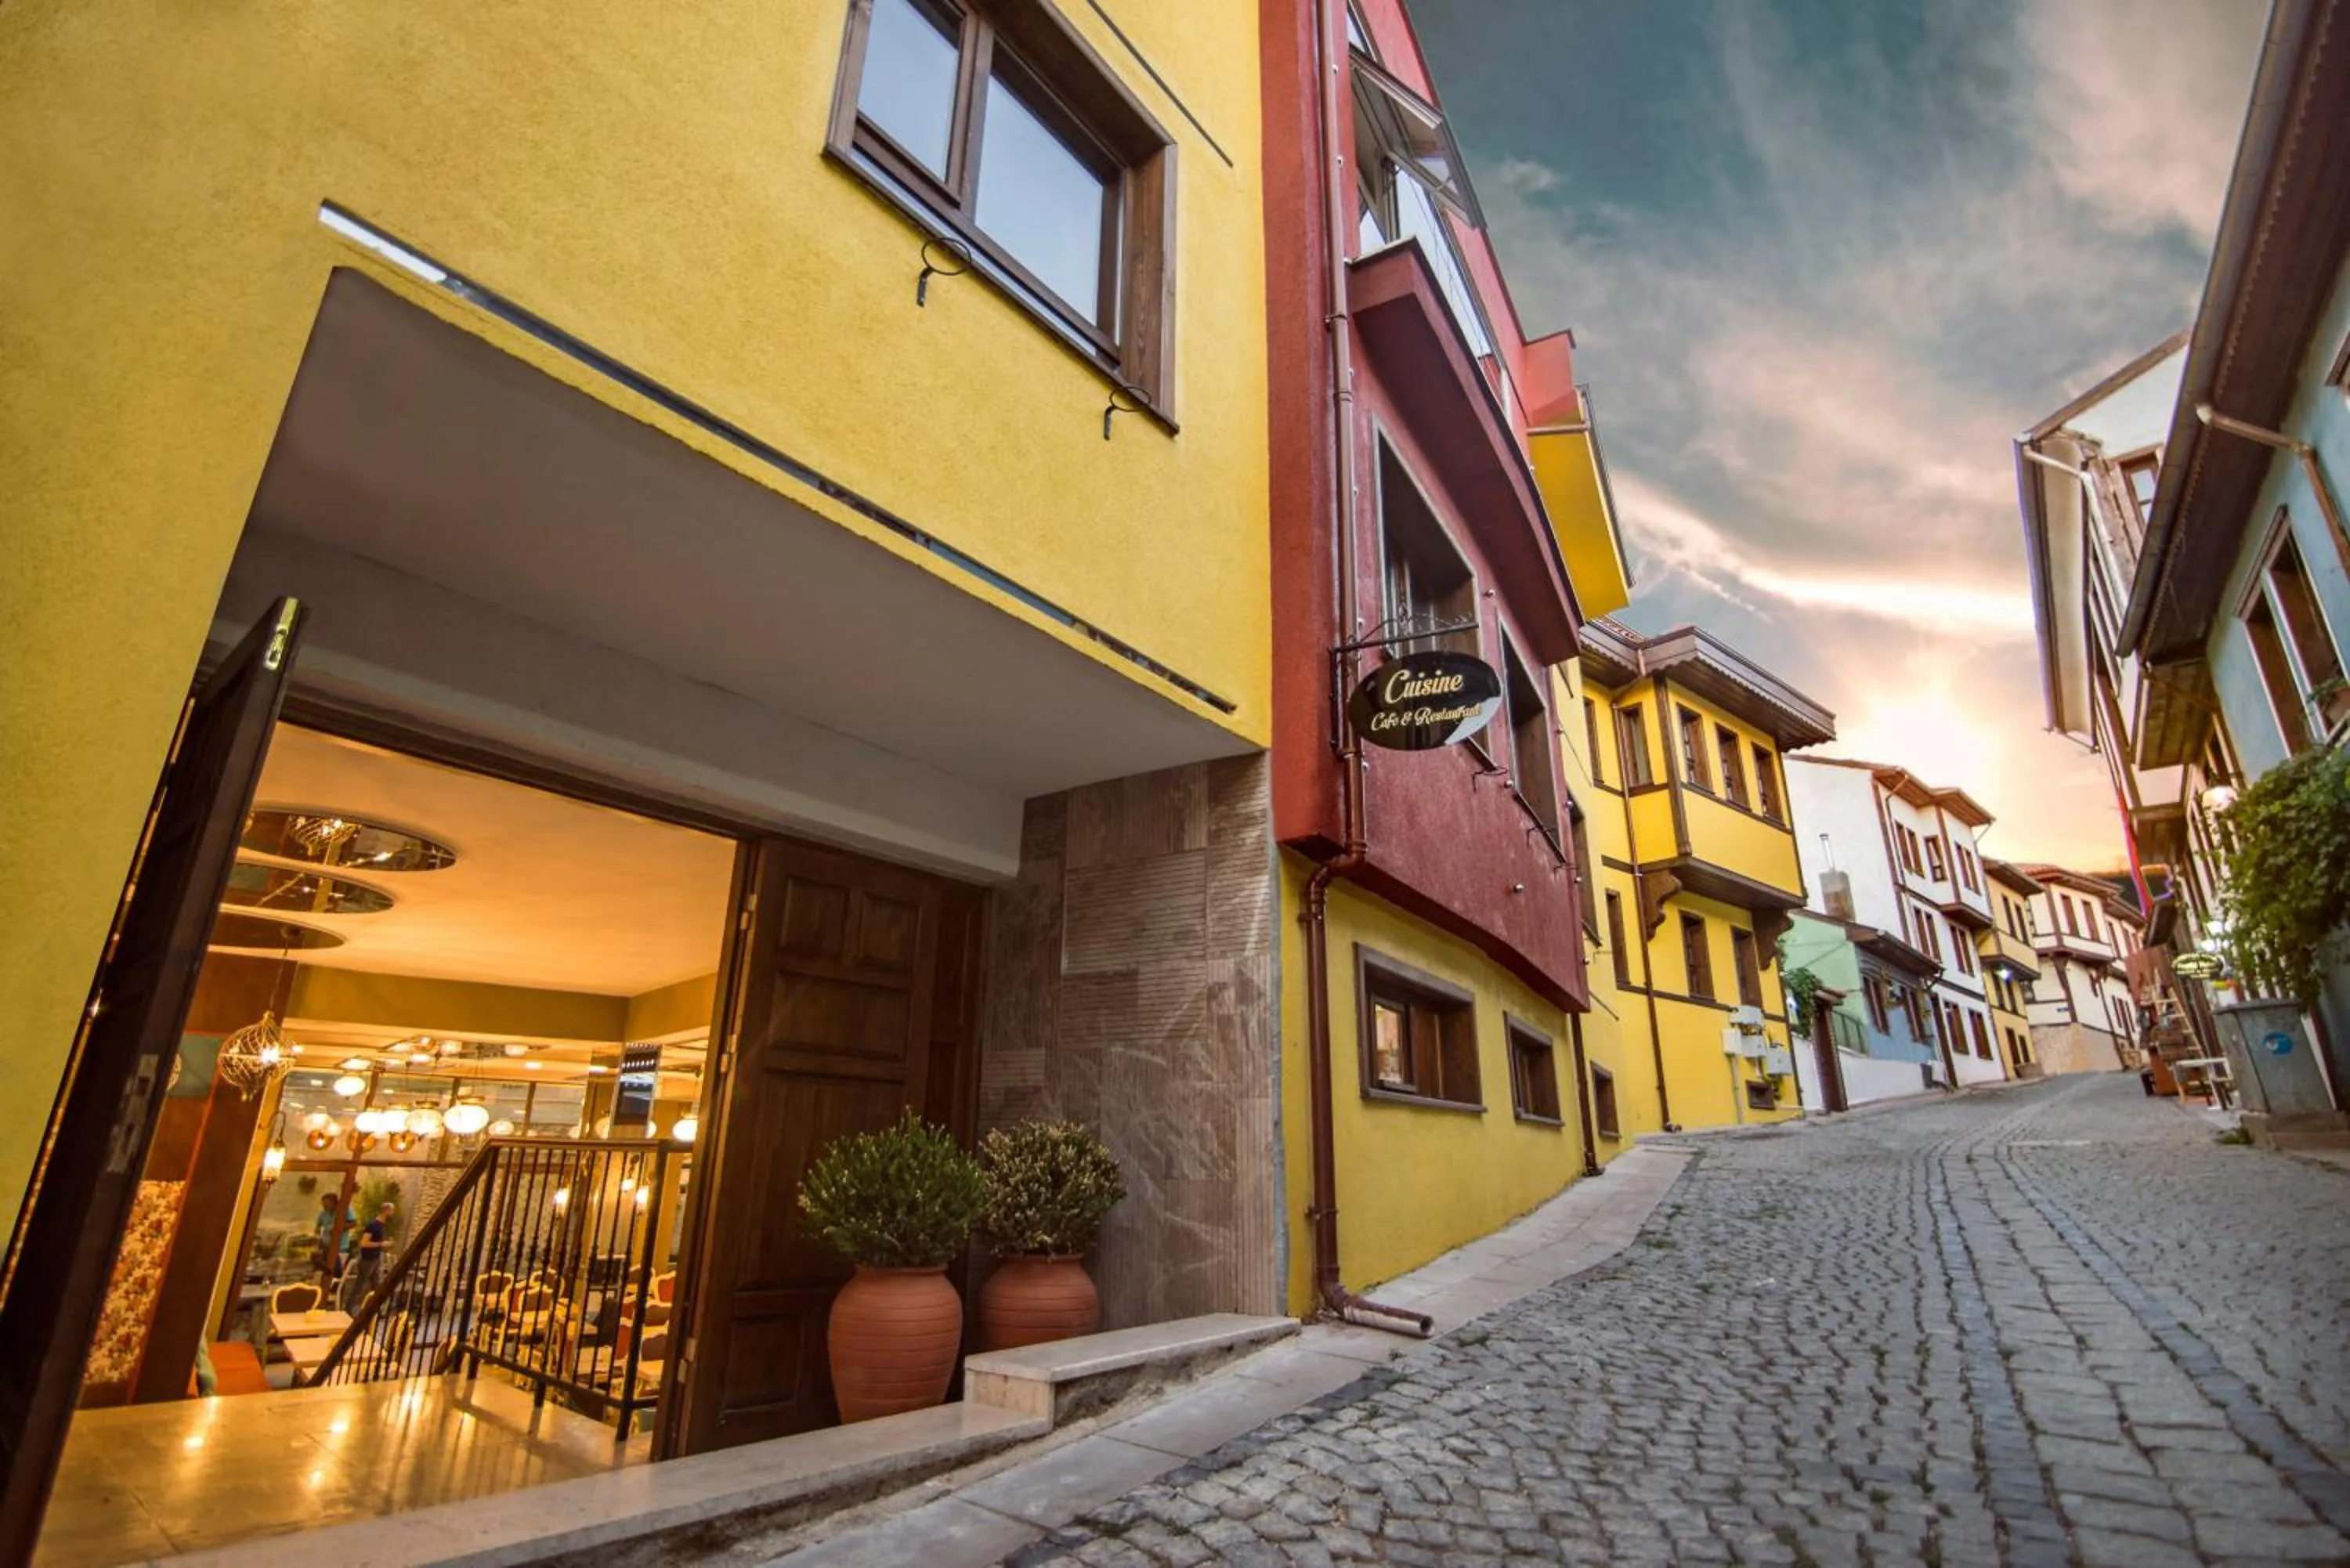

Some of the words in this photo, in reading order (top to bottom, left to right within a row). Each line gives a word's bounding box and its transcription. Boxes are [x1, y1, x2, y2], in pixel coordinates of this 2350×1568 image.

[1385, 670, 1463, 703] Cuisine
[1371, 712, 1399, 731] Cafe
[1401, 710, 1412, 726] &
